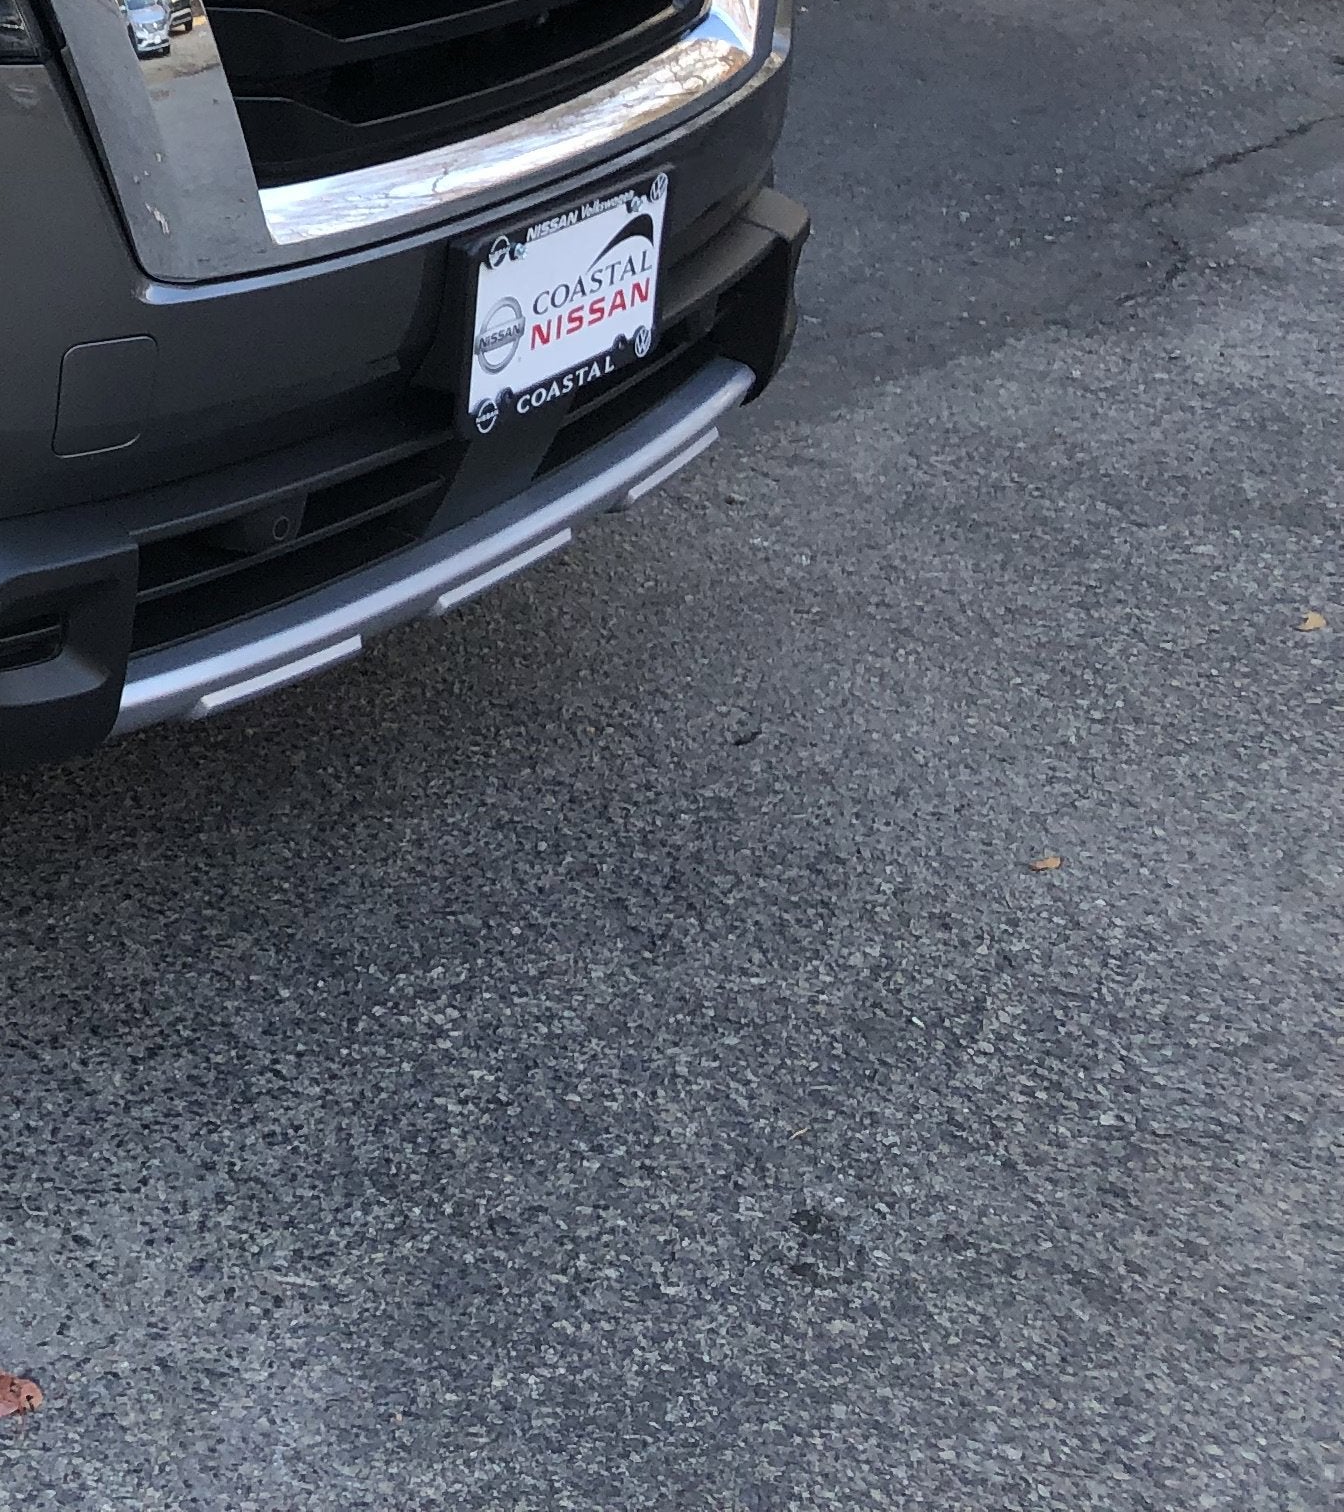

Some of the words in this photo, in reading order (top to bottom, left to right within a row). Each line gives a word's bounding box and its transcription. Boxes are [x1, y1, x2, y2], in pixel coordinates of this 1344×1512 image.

[526, 209, 580, 243] NISSAN
[532, 250, 653, 316] COASTAL
[479, 323, 522, 350] NISSAN
[530, 277, 651, 351] NISSAN
[516, 355, 615, 414] COASTAL
